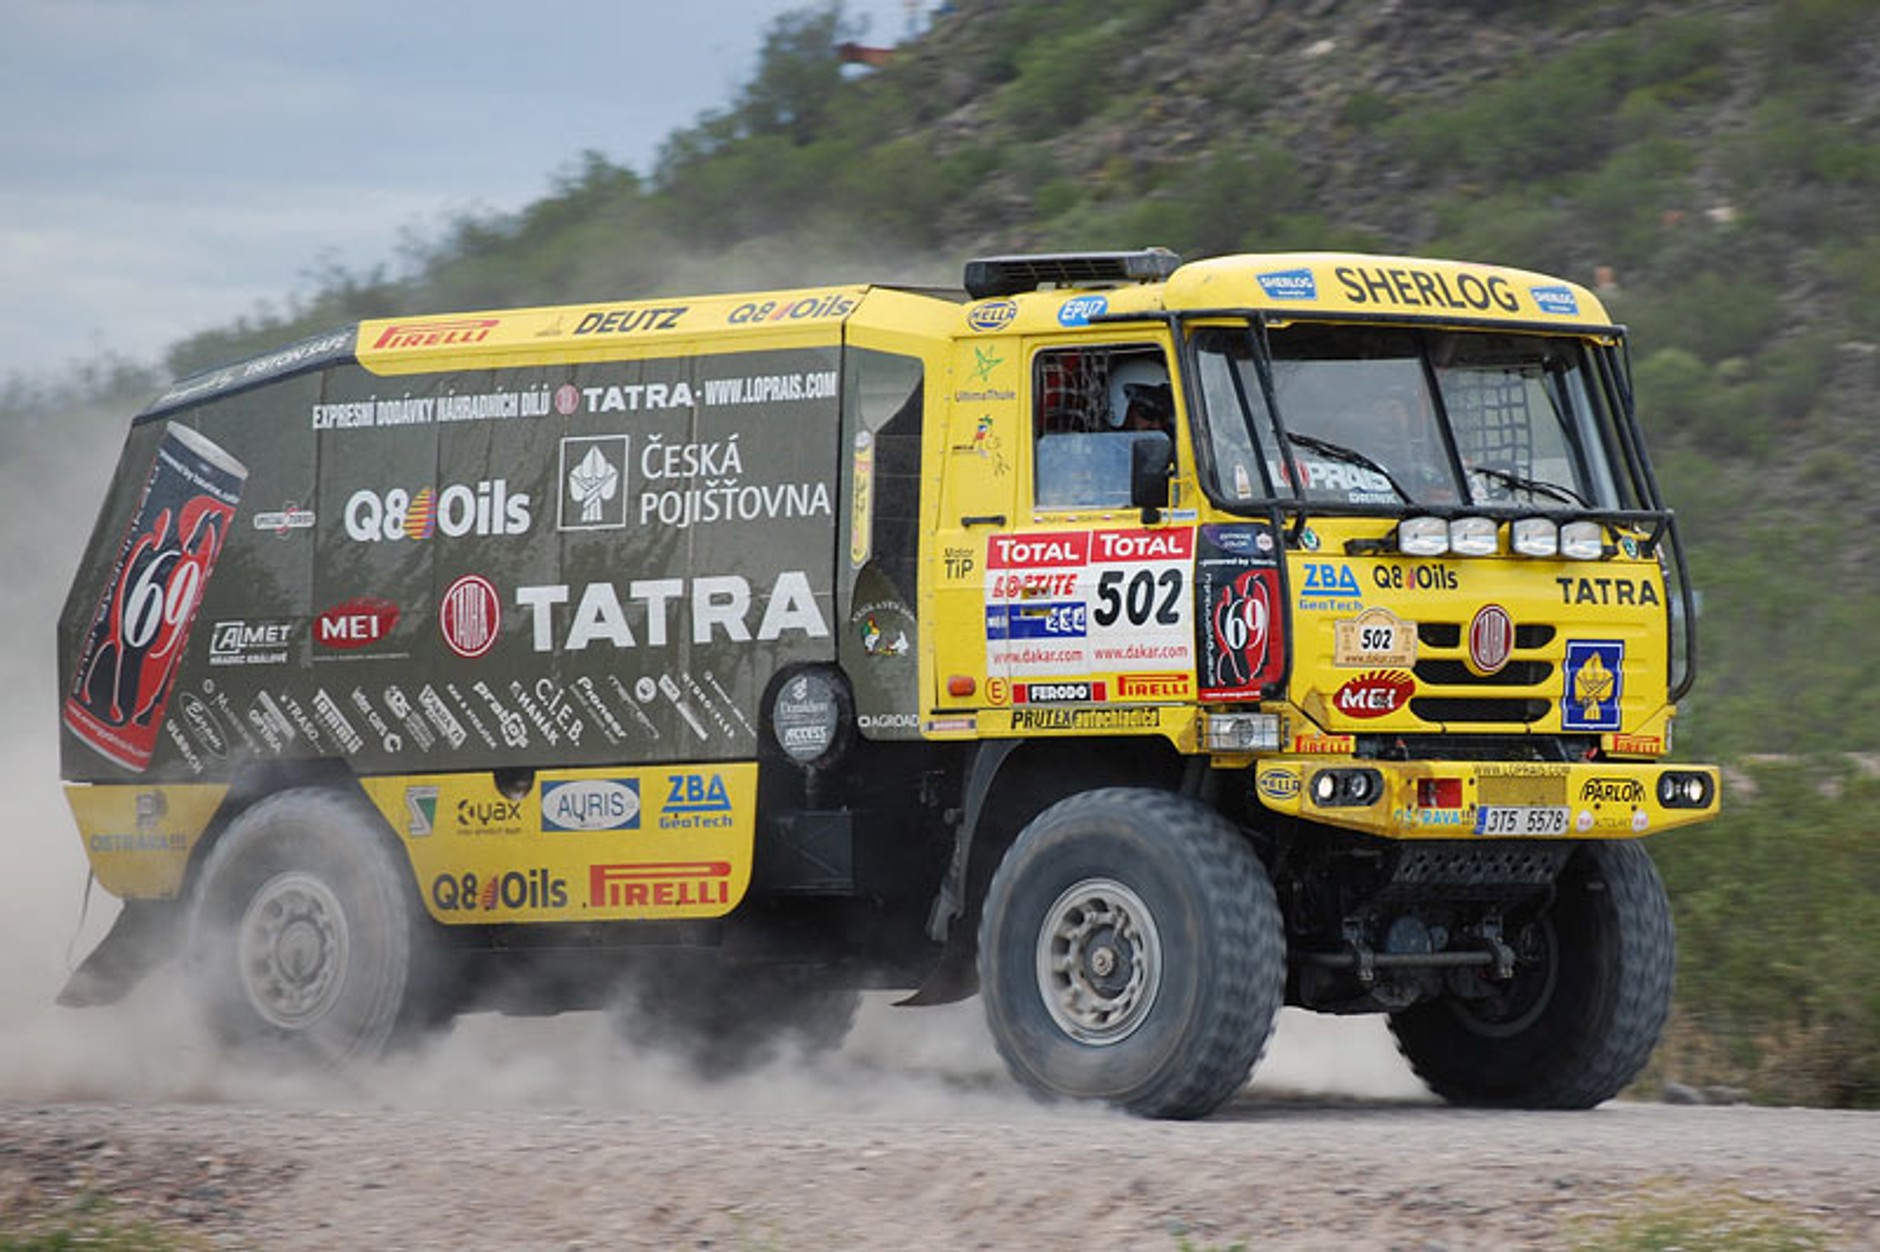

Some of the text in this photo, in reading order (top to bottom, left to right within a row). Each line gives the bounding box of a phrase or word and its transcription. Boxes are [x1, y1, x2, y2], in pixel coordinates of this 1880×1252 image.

[1335, 267, 1520, 312] SHERLOG
[574, 307, 689, 335] DEUTZ
[728, 295, 854, 325] Q8 Oils
[373, 319, 500, 349] PIRELLI
[313, 395, 376, 429] EXPRESNÍ
[377, 392, 434, 426] DODÁVKY
[437, 387, 518, 423] NÁHRADNÍCH
[583, 382, 694, 412] TATRA
[705, 371, 838, 406] WWW.LOPRAIS.COM
[641, 433, 743, 480] ČESKÁ
[345, 479, 531, 542] Q8 Oils
[640, 479, 831, 527] POJIŠŤOVNA
[997, 534, 1184, 562] TOTAL TOTAL
[1302, 564, 1361, 592] ZBA
[1373, 564, 1458, 590] Q8 Oils
[124, 550, 200, 647] 69
[1094, 568, 1184, 627] 502
[1299, 600, 1364, 611] GeoTech
[1556, 577, 1660, 607] TATRA
[516, 571, 829, 651] TATRA
[1225, 599, 1267, 651] 69
[322, 615, 379, 639] MEI
[1361, 629, 1393, 650] 502
[993, 643, 1188, 665] www.dakar.com www.dakar.com
[1032, 685, 1088, 700] FERODO
[1118, 674, 1189, 696] PIRELLI
[1341, 687, 1397, 709] MEI
[1296, 734, 1350, 753] PIRELLI
[1613, 733, 1660, 753] PIRELLI
[665, 774, 730, 806] ZBA
[1582, 780, 1645, 802] PARLOK
[557, 792, 625, 822] AURIS
[1488, 809, 1563, 832] 3T5 5578
[658, 814, 733, 830] GeoTech
[432, 869, 568, 911] Q8 Oils
[589, 861, 732, 908] PIRELLI
